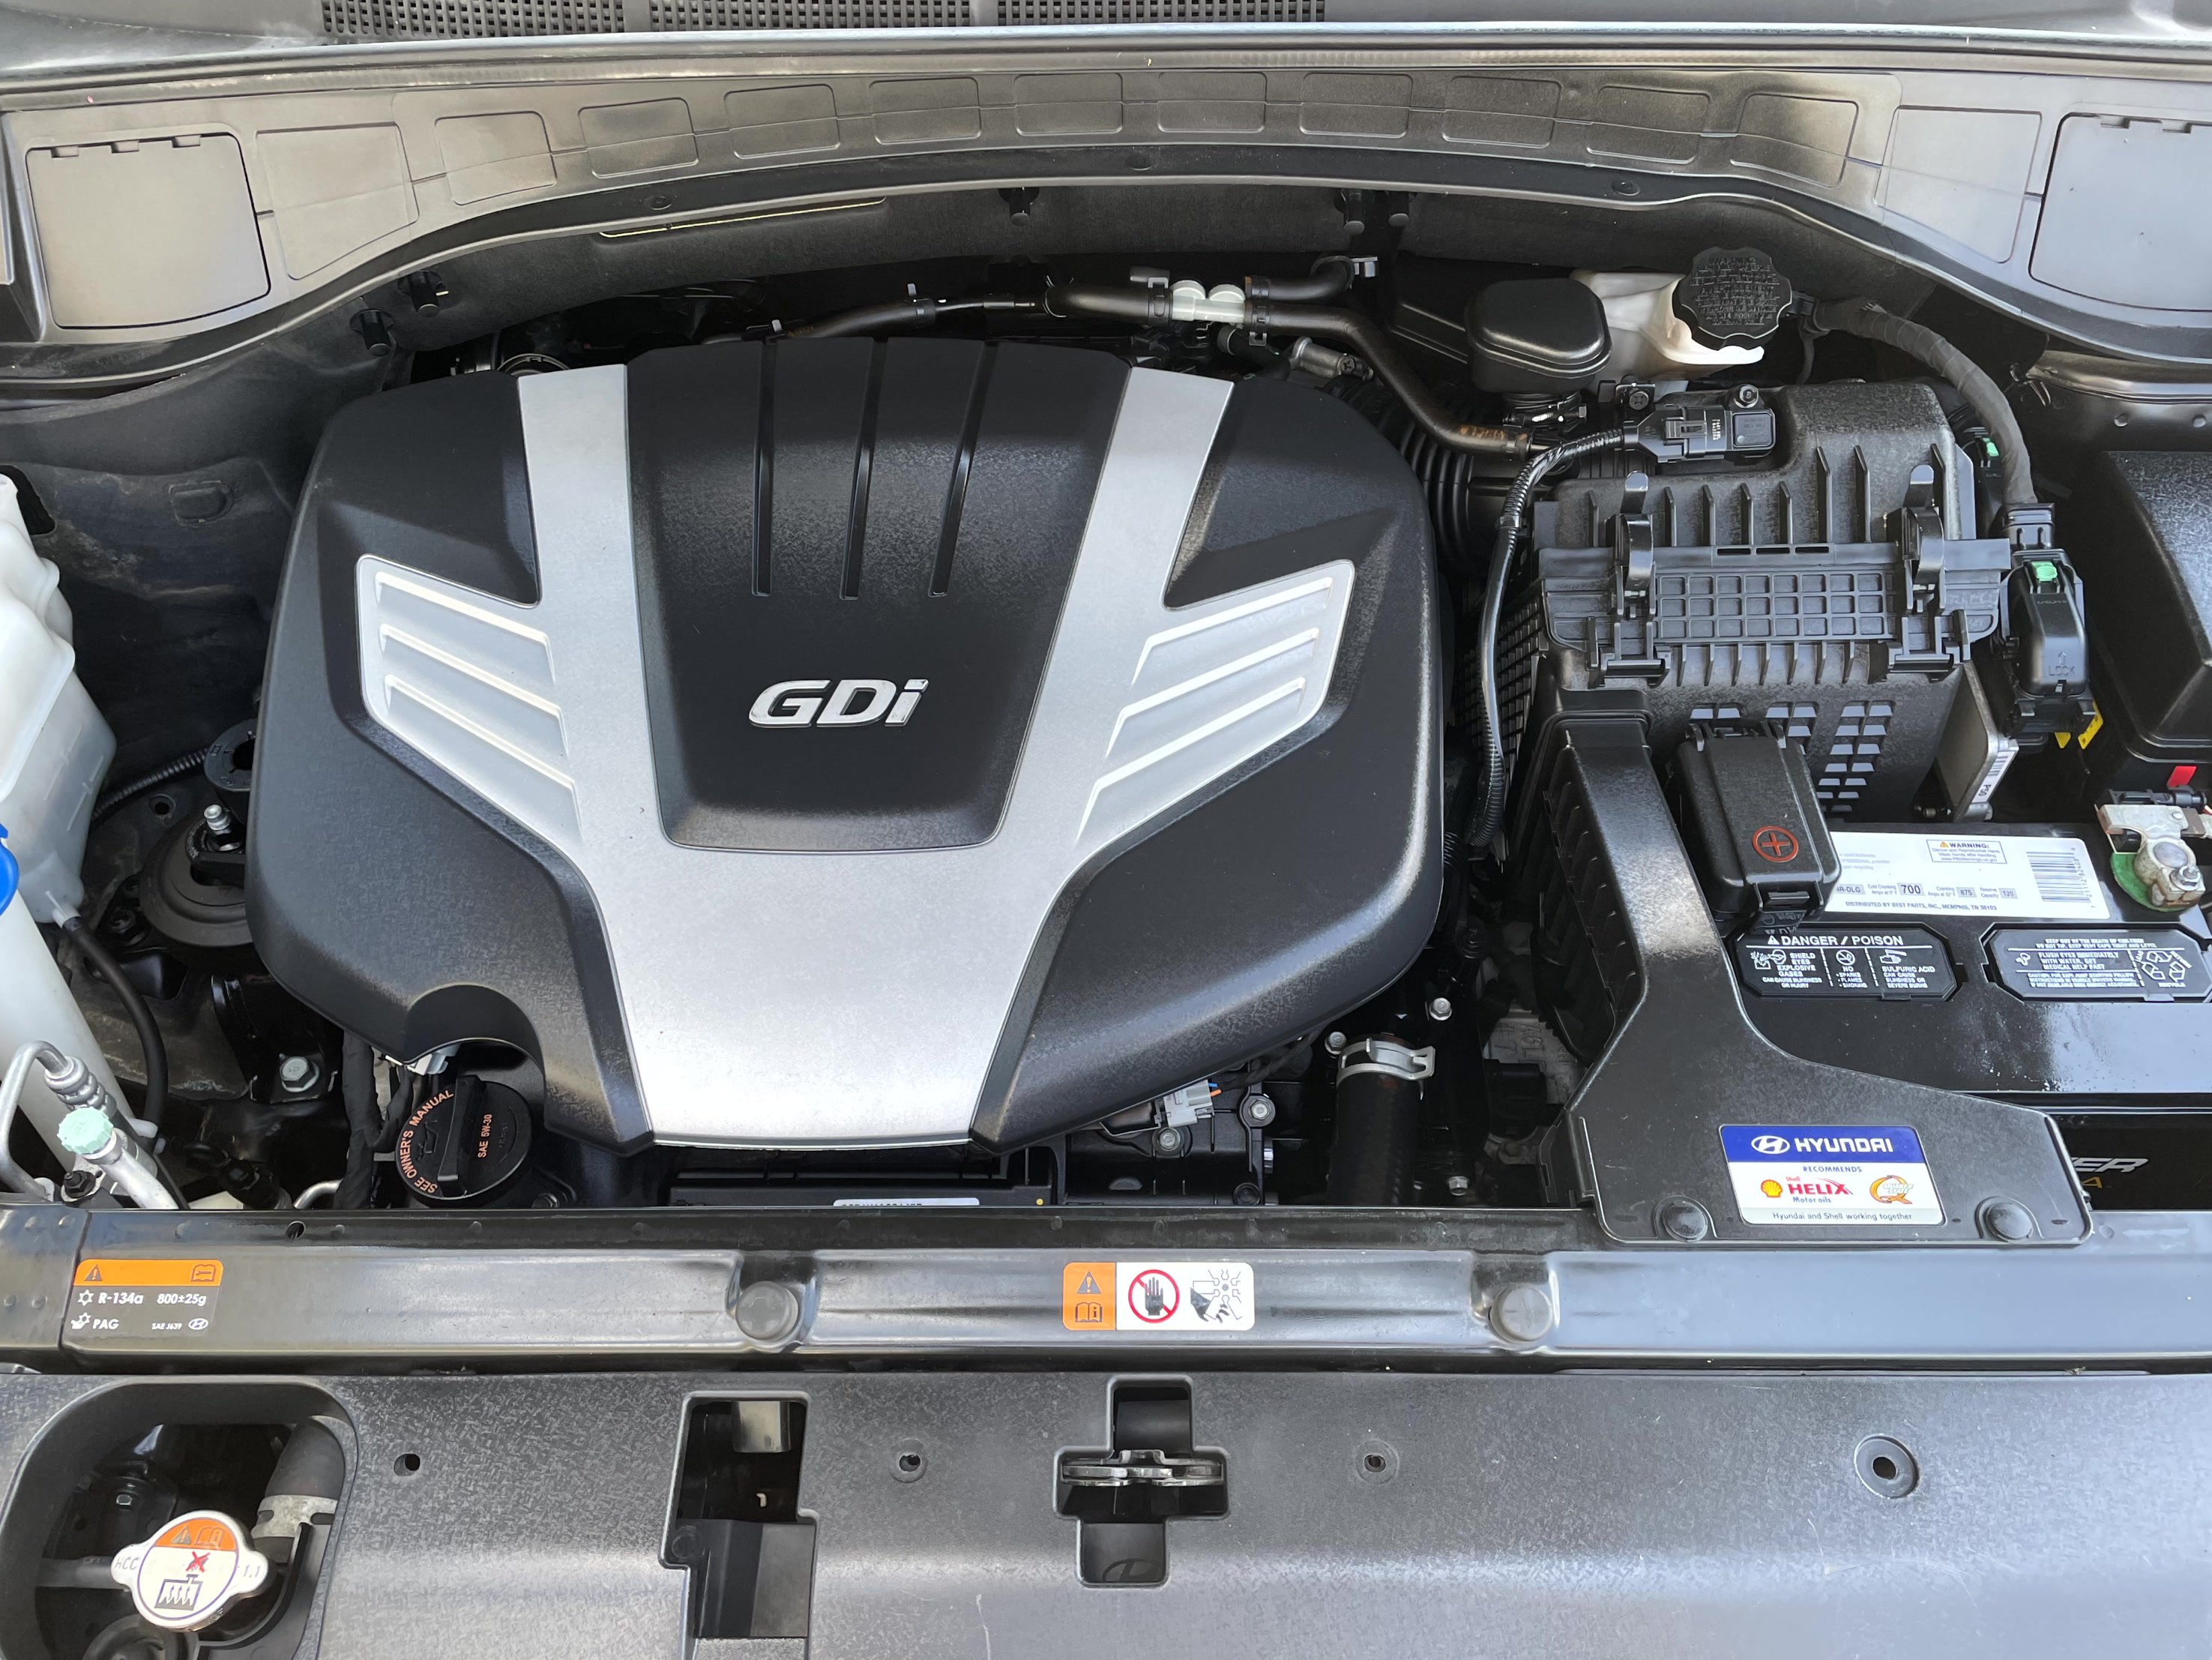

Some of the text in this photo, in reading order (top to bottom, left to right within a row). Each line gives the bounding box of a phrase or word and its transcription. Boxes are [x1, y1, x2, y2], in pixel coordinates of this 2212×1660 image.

[2049, 666, 2075, 676] LOCK
[749, 679, 929, 727] GDi
[1900, 885, 1921, 894] 700
[1781, 936, 1838, 945] DANGER
[1851, 935, 1904, 945] POISON
[400, 1089, 454, 1194] SEE OWNER'S MANUAL
[477, 1114, 492, 1158] SAE 5W-30
[1794, 1138, 1893, 1152] HYUNDAI
[2071, 1157, 2149, 1173] ER
[1788, 1183, 1851, 1195] HELIX
[1773, 1212, 1805, 1221] Hyundai
[1845, 1212, 1877, 1221] working
[1879, 1213, 1912, 1221] together
[98, 1293, 207, 1306] R-134a 800±25g
[93, 1319, 120, 1329] PAG
[114, 1557, 140, 1571] HCC
[243, 1564, 261, 1578] 1.1
